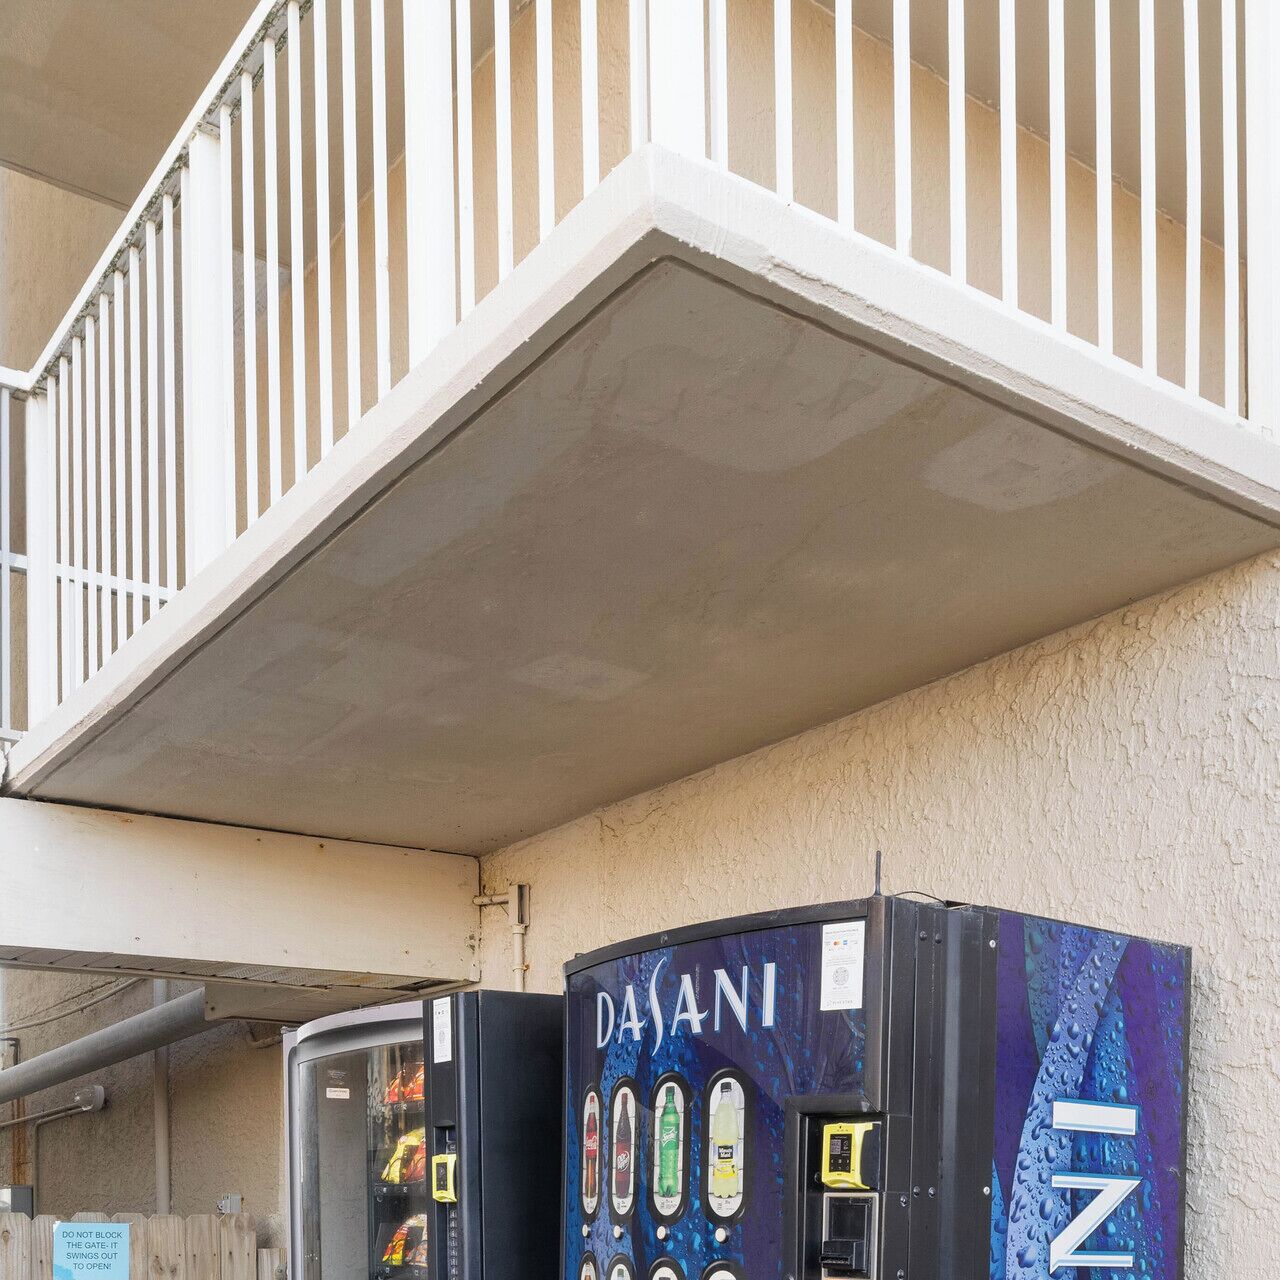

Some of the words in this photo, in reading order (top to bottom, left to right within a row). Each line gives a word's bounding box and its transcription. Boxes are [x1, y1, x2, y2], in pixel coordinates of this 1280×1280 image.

[596, 956, 776, 1057] DASANI
[62, 1231, 75, 1239] DO
[76, 1231, 93, 1239] NOT
[95, 1231, 123, 1239] BLOCK
[66, 1241, 82, 1249] THE
[84, 1241, 109, 1249] GATE-
[110, 1241, 118, 1249] IT
[66, 1252, 99, 1260] SWINGS
[101, 1252, 118, 1260] OUT
[73, 1262, 84, 1270] TO
[86, 1262, 112, 1270] OPEN!
